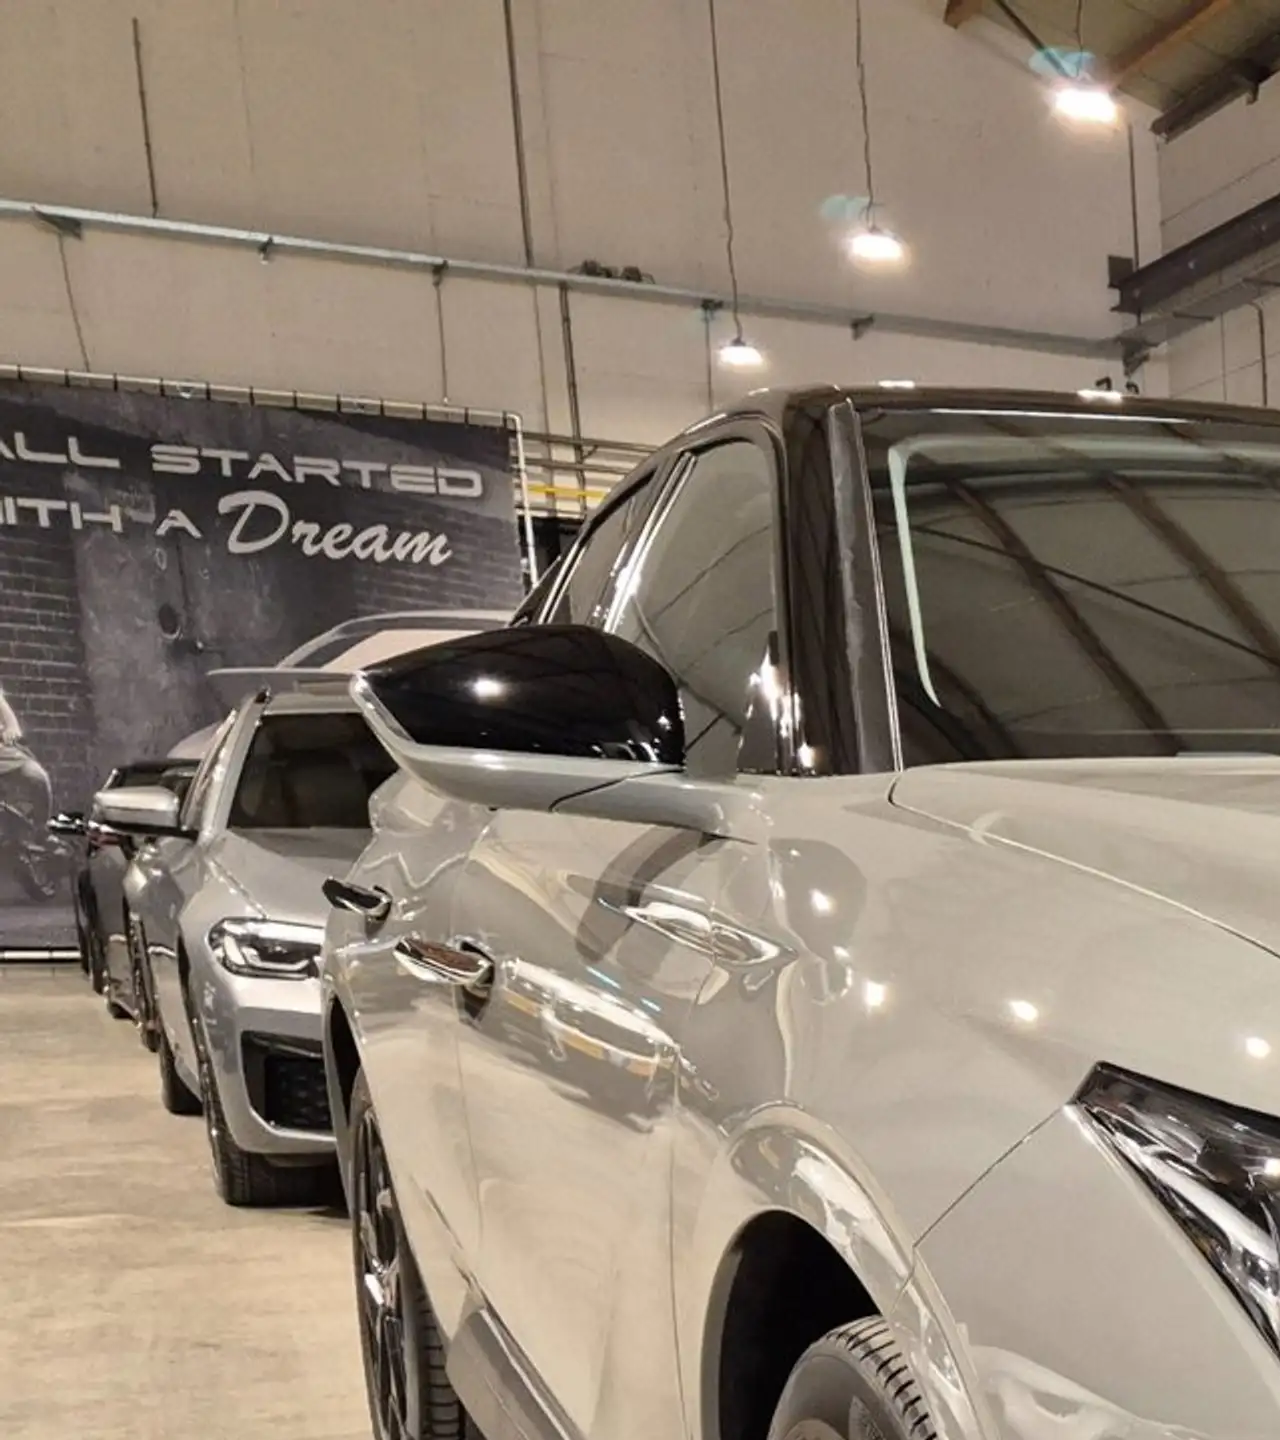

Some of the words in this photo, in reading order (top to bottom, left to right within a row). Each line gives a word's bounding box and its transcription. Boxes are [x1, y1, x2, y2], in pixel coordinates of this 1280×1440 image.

[149, 443, 485, 499] STARTED
[0, 496, 123, 533] ITH
[155, 508, 202, 539] A
[217, 489, 454, 566] Dream
